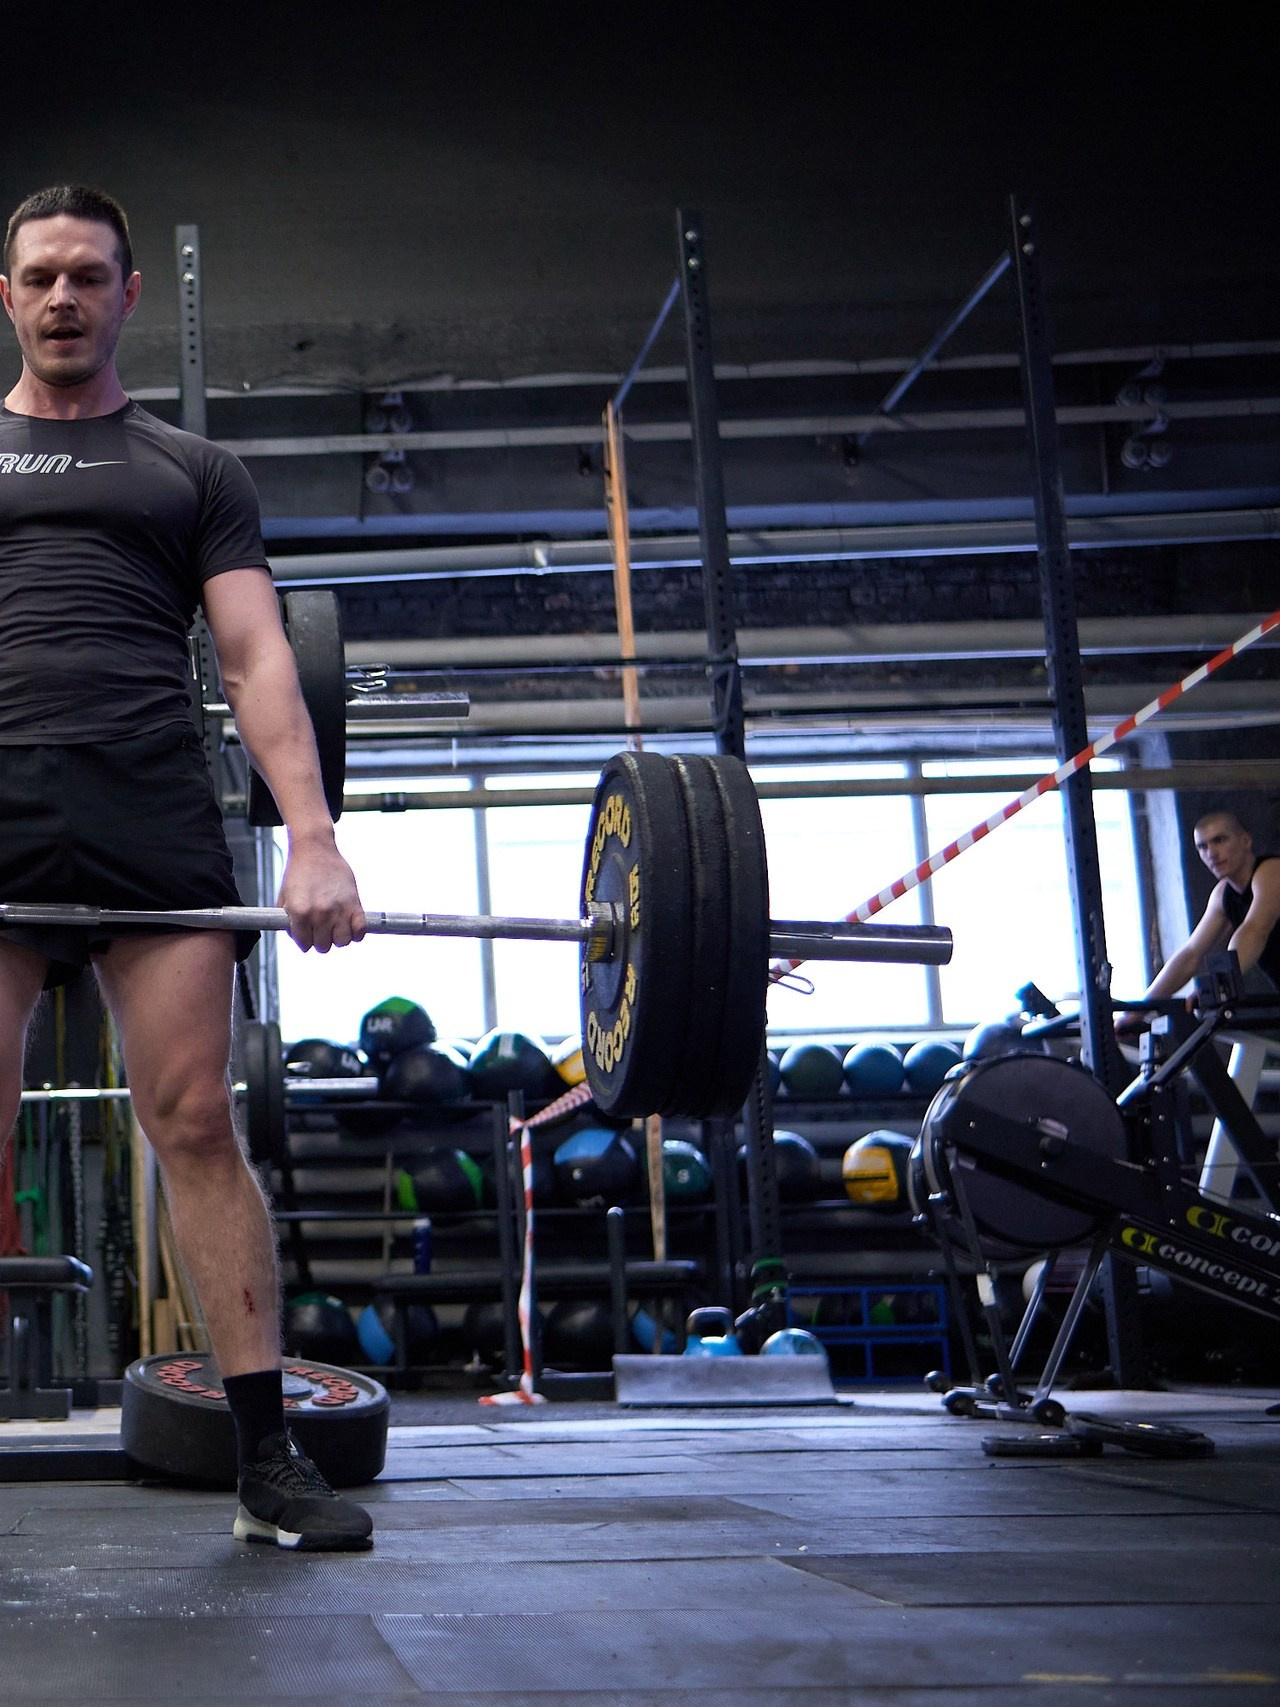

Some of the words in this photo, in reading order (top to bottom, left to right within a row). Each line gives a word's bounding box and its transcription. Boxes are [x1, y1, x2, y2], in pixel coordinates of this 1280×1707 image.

[585, 794, 631, 902] RECORD
[587, 963, 636, 1073] RECORD
[1158, 1243, 1269, 1298] concept
